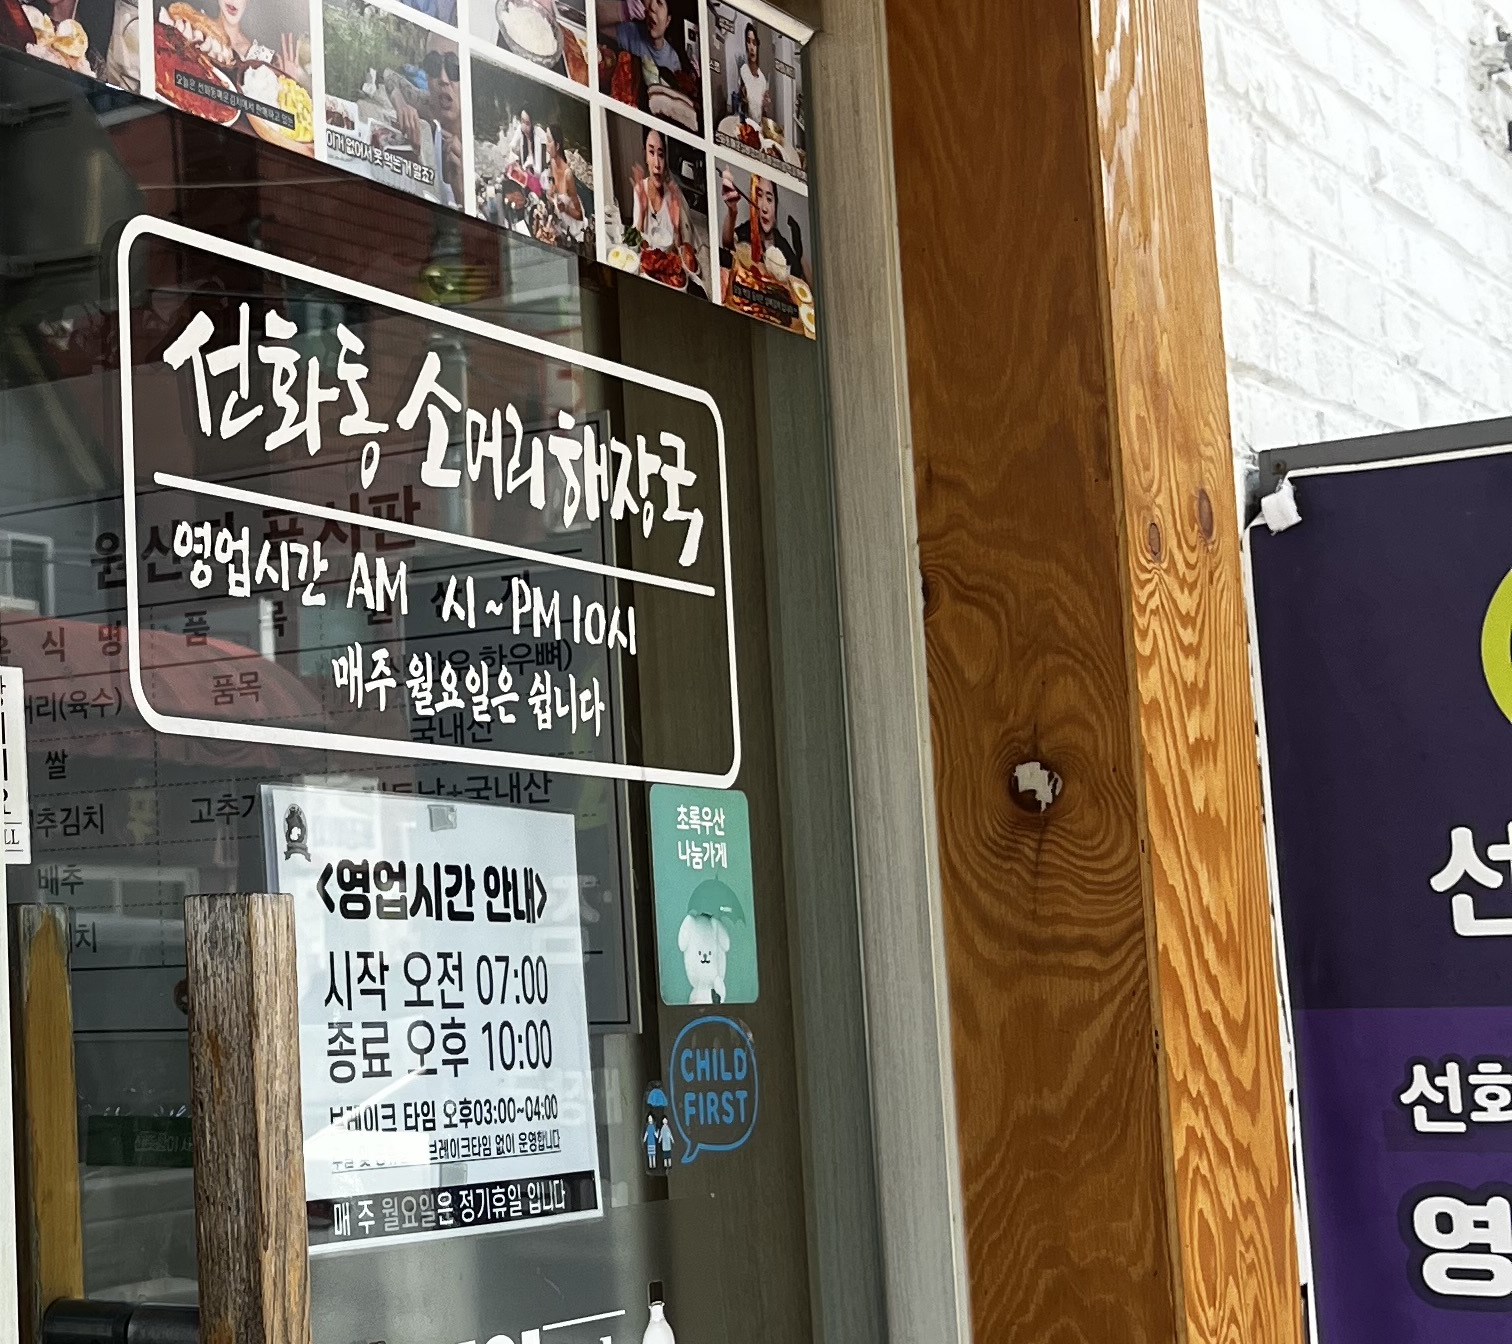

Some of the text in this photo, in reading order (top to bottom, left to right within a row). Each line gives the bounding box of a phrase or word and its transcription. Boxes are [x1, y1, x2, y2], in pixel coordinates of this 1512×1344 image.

[326, 130, 435, 186] 이거 없어서 못 먹는거 알죠?
[163, 302, 704, 568] 선화동 소머리해장국
[90, 512, 234, 591] 원산
[173, 518, 330, 607] 영업시간
[346, 551, 408, 615] AM
[211, 670, 262, 707] 품목
[331, 641, 397, 712] 매주
[405, 652, 520, 724] 월요일은
[527, 669, 605, 737] 쉽니다
[28, 802, 105, 837] 추김치
[676, 803, 726, 836] 초록우산
[677, 839, 728, 870] 나눔가게
[37, 865, 85, 896] 배추
[316, 858, 476, 923] <영업시간
[483, 864, 548, 924] 안내>
[69, 921, 98, 954] 치
[324, 950, 549, 1011] 시작 오전 07:00
[326, 1016, 553, 1084] 종료 오후 10:00
[680, 1047, 748, 1083] CHILD
[403, 1099, 437, 1132] 타임
[442, 1093, 559, 1130] 오후03:00~04:00
[684, 1090, 748, 1127] FIRST
[428, 1133, 493, 1161] 브레이크타임
[494, 1132, 515, 1156] 없이
[517, 1128, 561, 1153] 운영합니다
[381, 1190, 454, 1232] 월요일은
[458, 1182, 524, 1223] 정기휴일
[527, 1178, 566, 1212] 입니다
